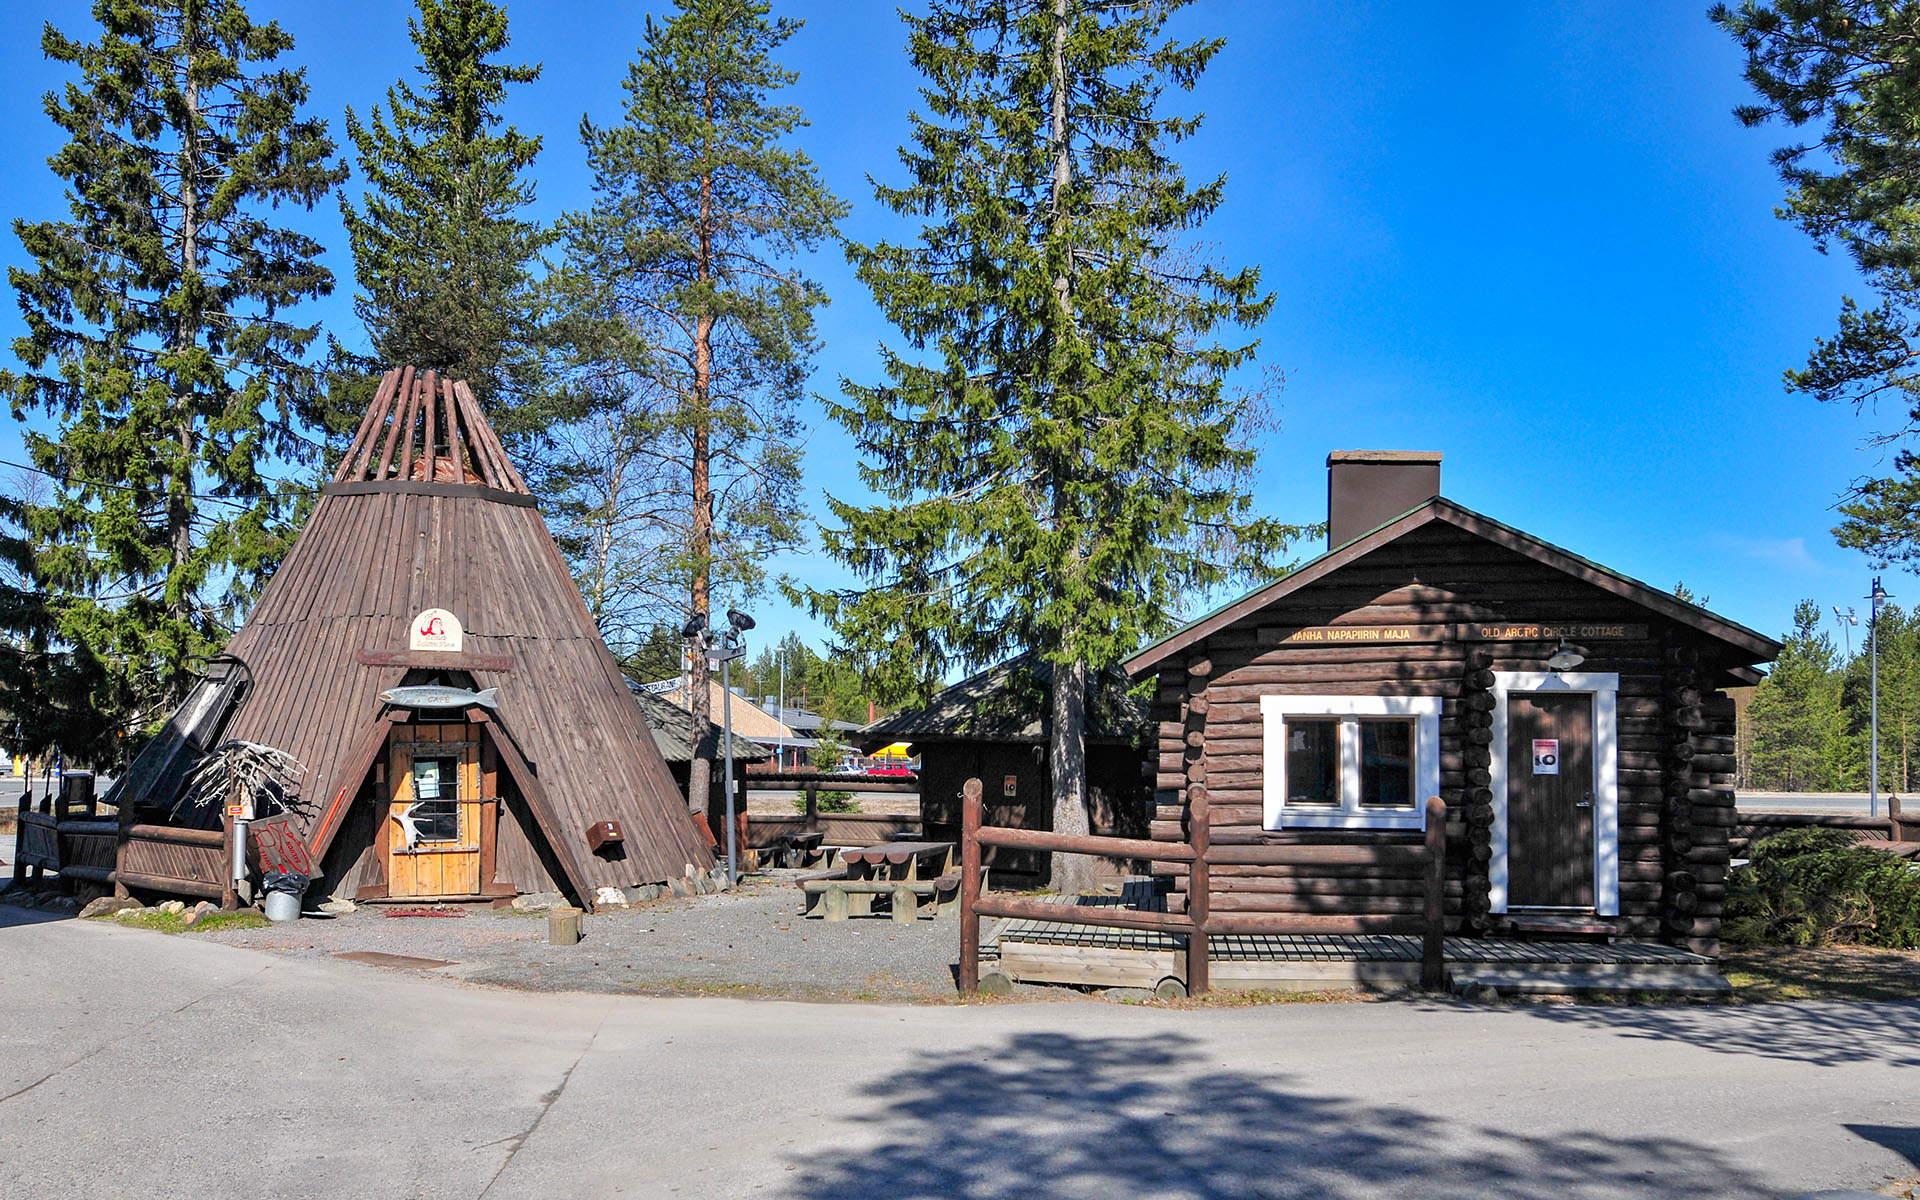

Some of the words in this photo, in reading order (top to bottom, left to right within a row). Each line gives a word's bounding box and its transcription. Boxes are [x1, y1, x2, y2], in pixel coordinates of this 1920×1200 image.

[1292, 630, 1322, 641] VANHA
[1327, 629, 1379, 640] NAPAPIIRIN
[1384, 629, 1410, 640] MAJA
[1481, 627, 1500, 638] OLD
[1504, 627, 1539, 638] ARCTIC
[1543, 626, 1576, 637] CIRCLE
[1581, 626, 1624, 637] COTTAGE
